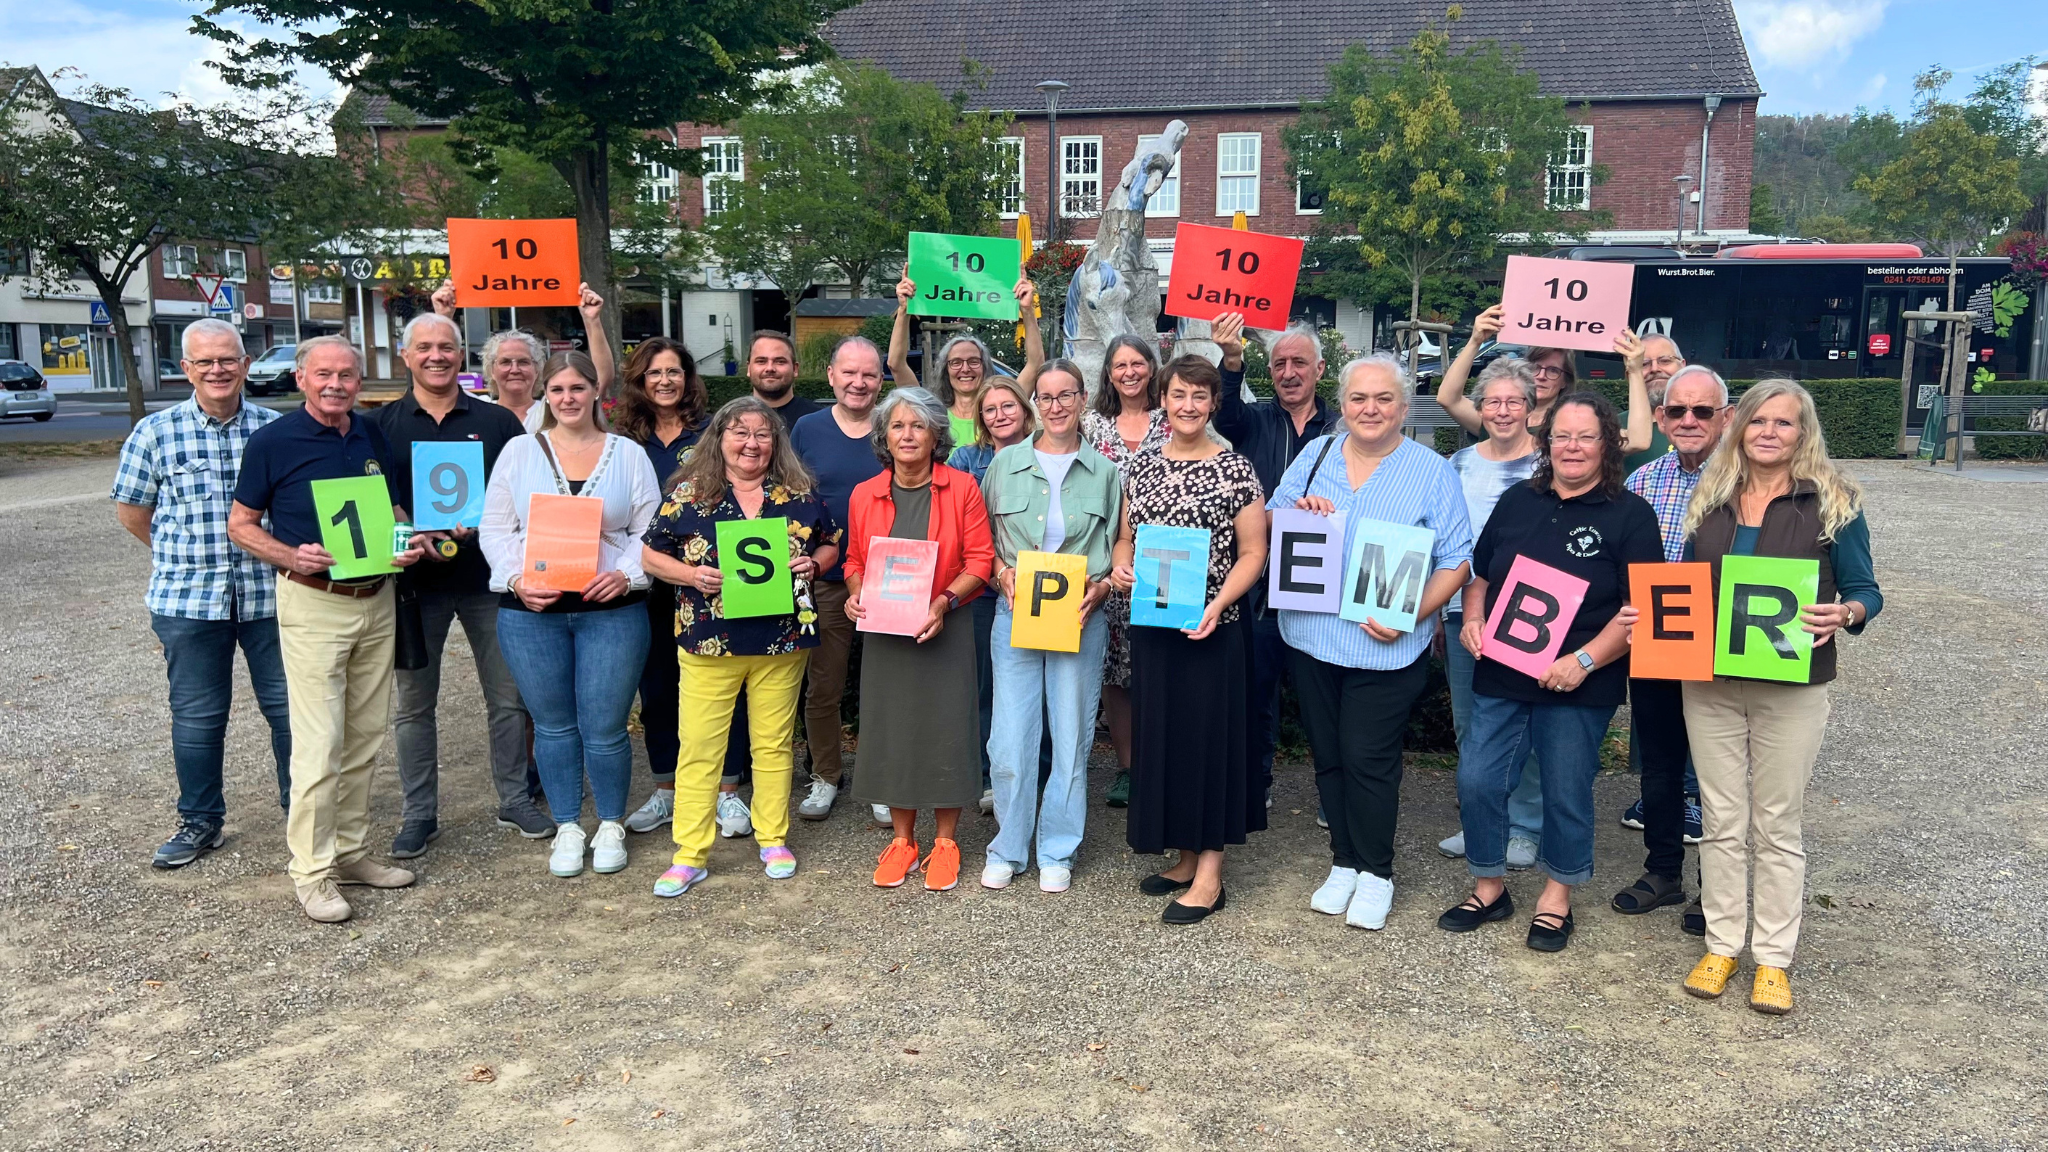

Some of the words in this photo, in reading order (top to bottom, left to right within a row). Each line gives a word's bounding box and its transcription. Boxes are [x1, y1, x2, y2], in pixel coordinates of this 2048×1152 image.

[492, 238, 537, 260] 10
[946, 252, 985, 273] 10
[1215, 248, 1260, 275] 10
[473, 274, 561, 291] Jahre
[1658, 268, 1715, 276] Wurst.Brot.Bier.
[1867, 266, 1905, 275] bestellen
[1907, 266, 1927, 275] oder
[1929, 266, 1964, 275] abhoen
[1883, 275, 1904, 284] 0241
[1906, 275, 1946, 284] 47581491
[925, 284, 1001, 304] Jahre
[1186, 283, 1271, 311] Jahre
[1544, 277, 1588, 302] 10
[1517, 312, 1605, 334] Jahre
[429, 462, 469, 514] 9
[331, 500, 368, 560] 1
[735, 536, 775, 585] S
[880, 555, 919, 602] E
[1142, 548, 1190, 609] T
[1278, 531, 1327, 595] E
[1352, 542, 1426, 615] M
[1030, 570, 1069, 617] P
[1493, 581, 1560, 654] B
[1650, 584, 1694, 641] E
[1729, 582, 1801, 661] R
